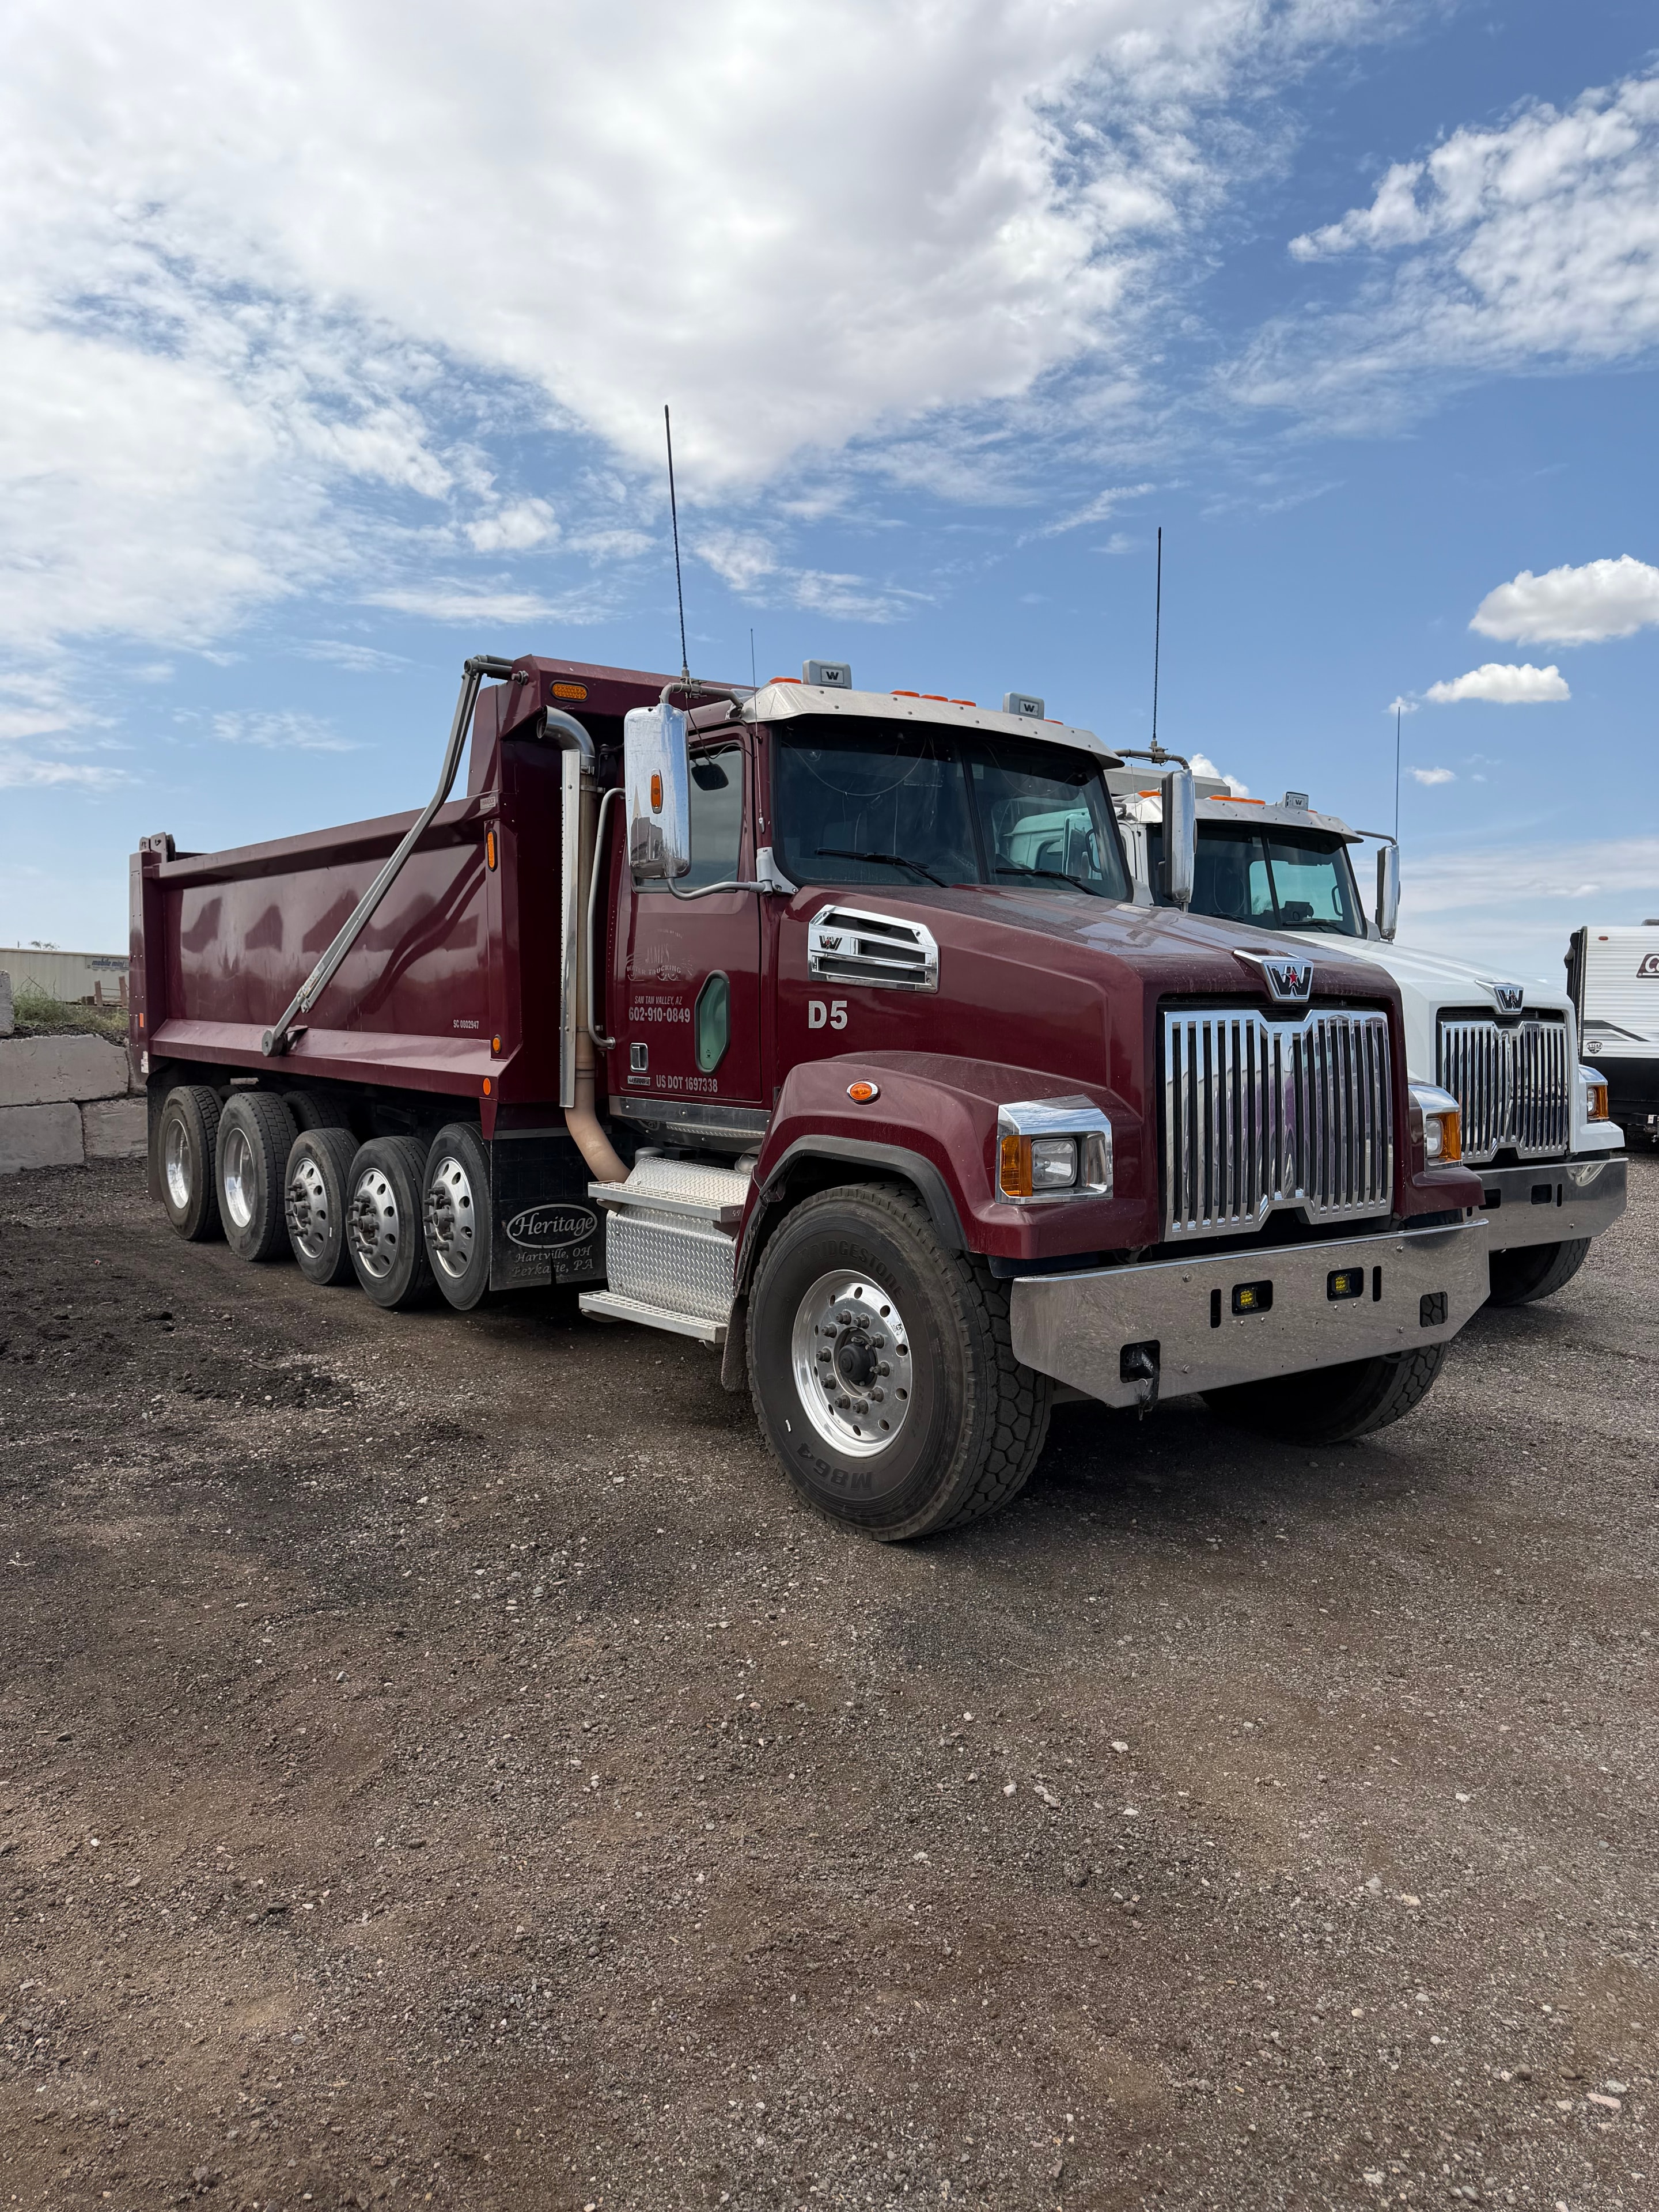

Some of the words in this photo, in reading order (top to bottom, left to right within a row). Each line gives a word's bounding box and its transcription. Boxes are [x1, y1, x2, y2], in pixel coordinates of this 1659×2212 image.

[649, 964, 681, 975] TRUCKING
[634, 995, 645, 1004] SAN
[645, 995, 655, 1004] TAN
[656, 996, 674, 1006] VALLEY,
[675, 996, 683, 1005] AZ
[453, 1019, 460, 1028] SC
[628, 1006, 691, 1023] 602-910-0849
[808, 1001, 848, 1029] D5
[656, 1074, 666, 1088] US
[668, 1075, 683, 1089] DOT
[685, 1077, 718, 1093] 1697338
[513, 1213, 593, 1236] Heritage
[514, 1248, 569, 1263] Hartville,
[573, 1245, 593, 1257] OH
[512, 1263, 569, 1278] Perkaie,
[573, 1259, 593, 1271] PA
[796, 1442, 873, 1491] M864
